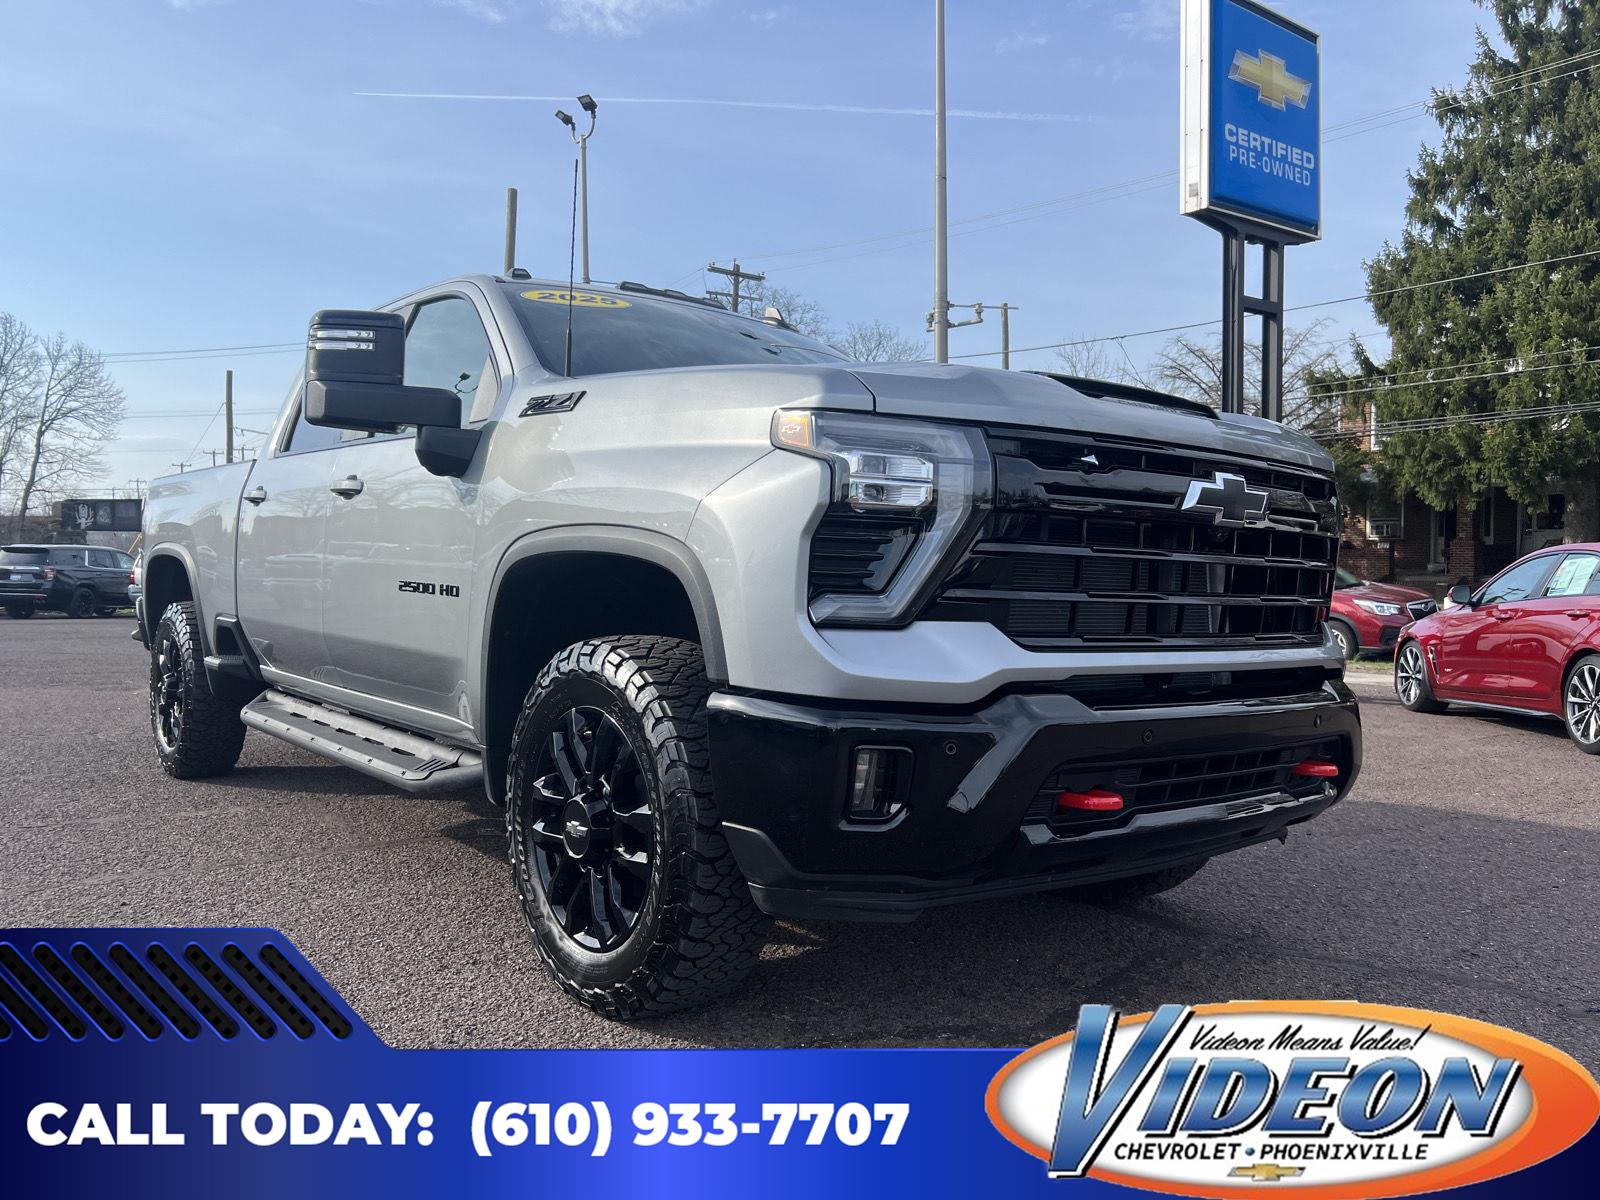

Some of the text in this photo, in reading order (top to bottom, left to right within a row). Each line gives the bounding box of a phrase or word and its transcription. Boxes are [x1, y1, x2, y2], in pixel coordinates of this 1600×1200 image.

[1224, 123, 1315, 169] CERTIFIED
[1229, 145, 1311, 186] PRE-OWNED
[537, 291, 617, 305] 2025
[518, 390, 587, 418] Z71
[398, 580, 460, 598] 2500 HD
